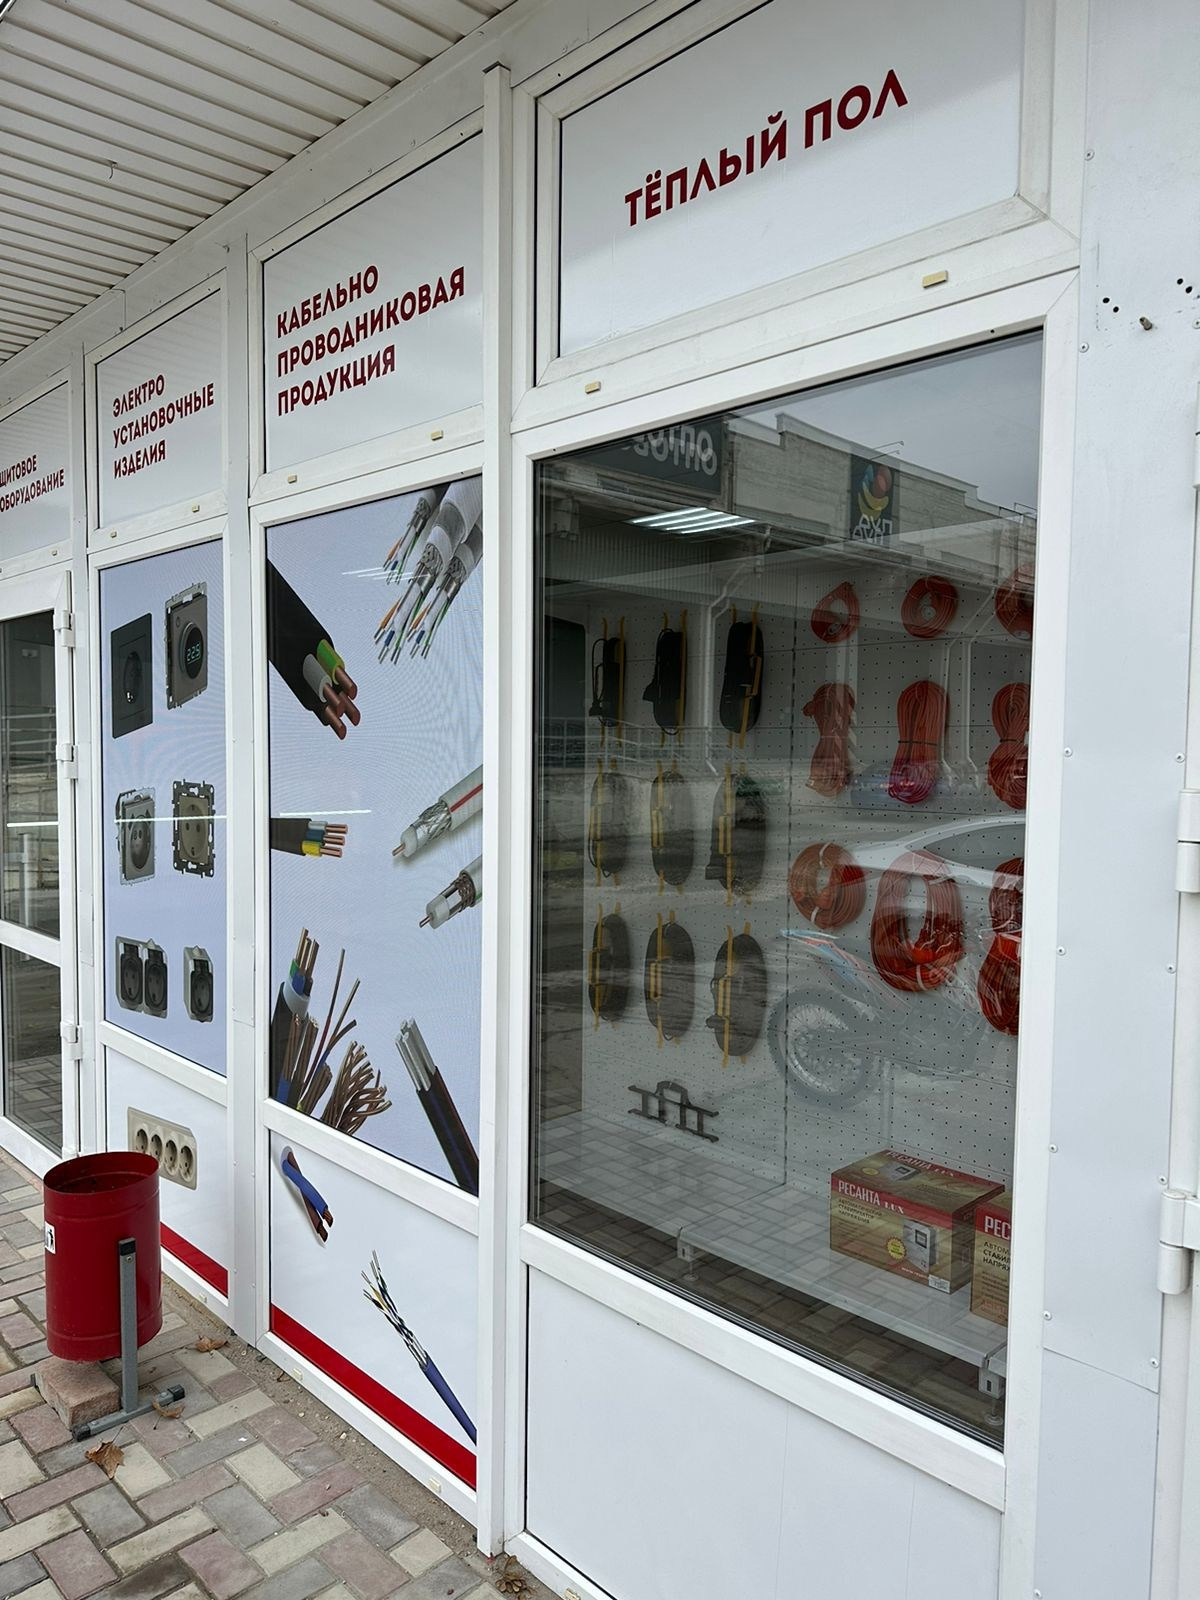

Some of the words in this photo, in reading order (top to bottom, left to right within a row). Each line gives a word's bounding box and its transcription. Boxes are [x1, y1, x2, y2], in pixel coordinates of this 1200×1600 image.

[625, 110, 787, 227] ТЁПЛЫЙ
[804, 68, 908, 149] ПОЛ
[277, 265, 379, 339] КАБЕЛЬНО
[277, 266, 465, 378] ПРОВОДНИКОВАЯ
[112, 374, 165, 418] ЭЛЕКТРО
[278, 344, 396, 417] ПРОДУКЦИЯ
[112, 382, 215, 449] УСТАНОВОЧНЫЕ
[0, 454, 37, 488] ЩИТОВОЕ
[113, 439, 166, 480] ИЗДЕЛИЯ
[0, 468, 65, 513] ОБОРУДОВАНИЕ
[838, 1180, 880, 1206] РЕСАНТА
[884, 1201, 904, 1215] LUX
